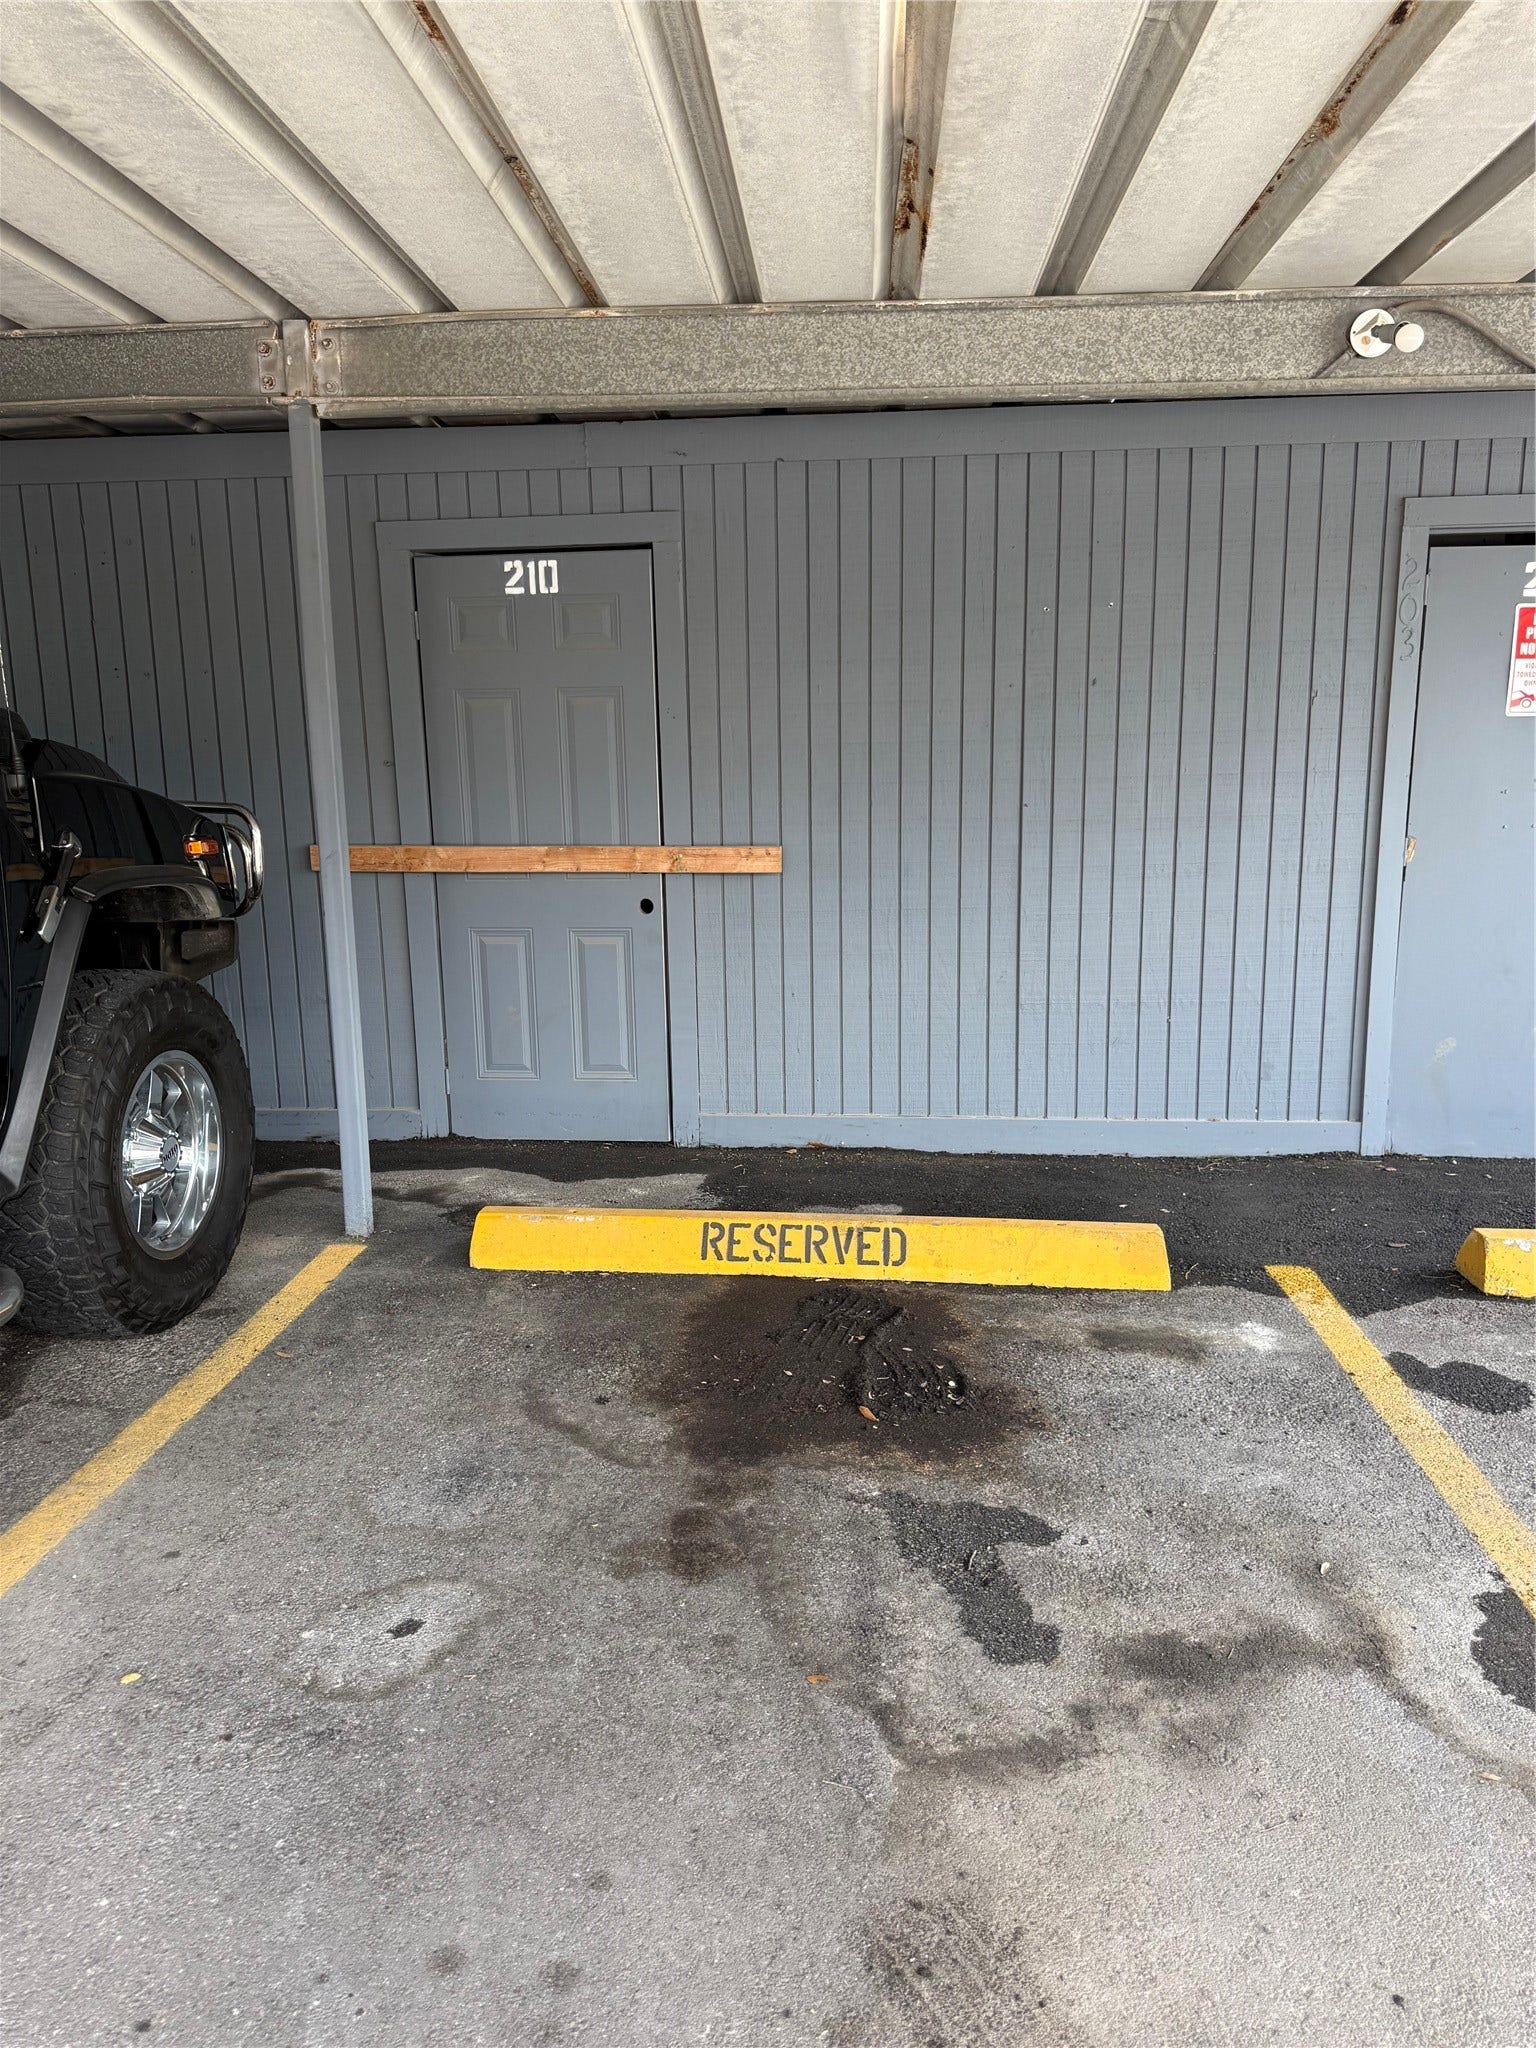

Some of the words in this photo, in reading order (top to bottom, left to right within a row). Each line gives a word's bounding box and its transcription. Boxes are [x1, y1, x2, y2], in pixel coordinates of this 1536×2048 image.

[503, 559, 558, 595] 210
[1399, 556, 1420, 661] 203
[701, 1221, 907, 1267] RESERVED
